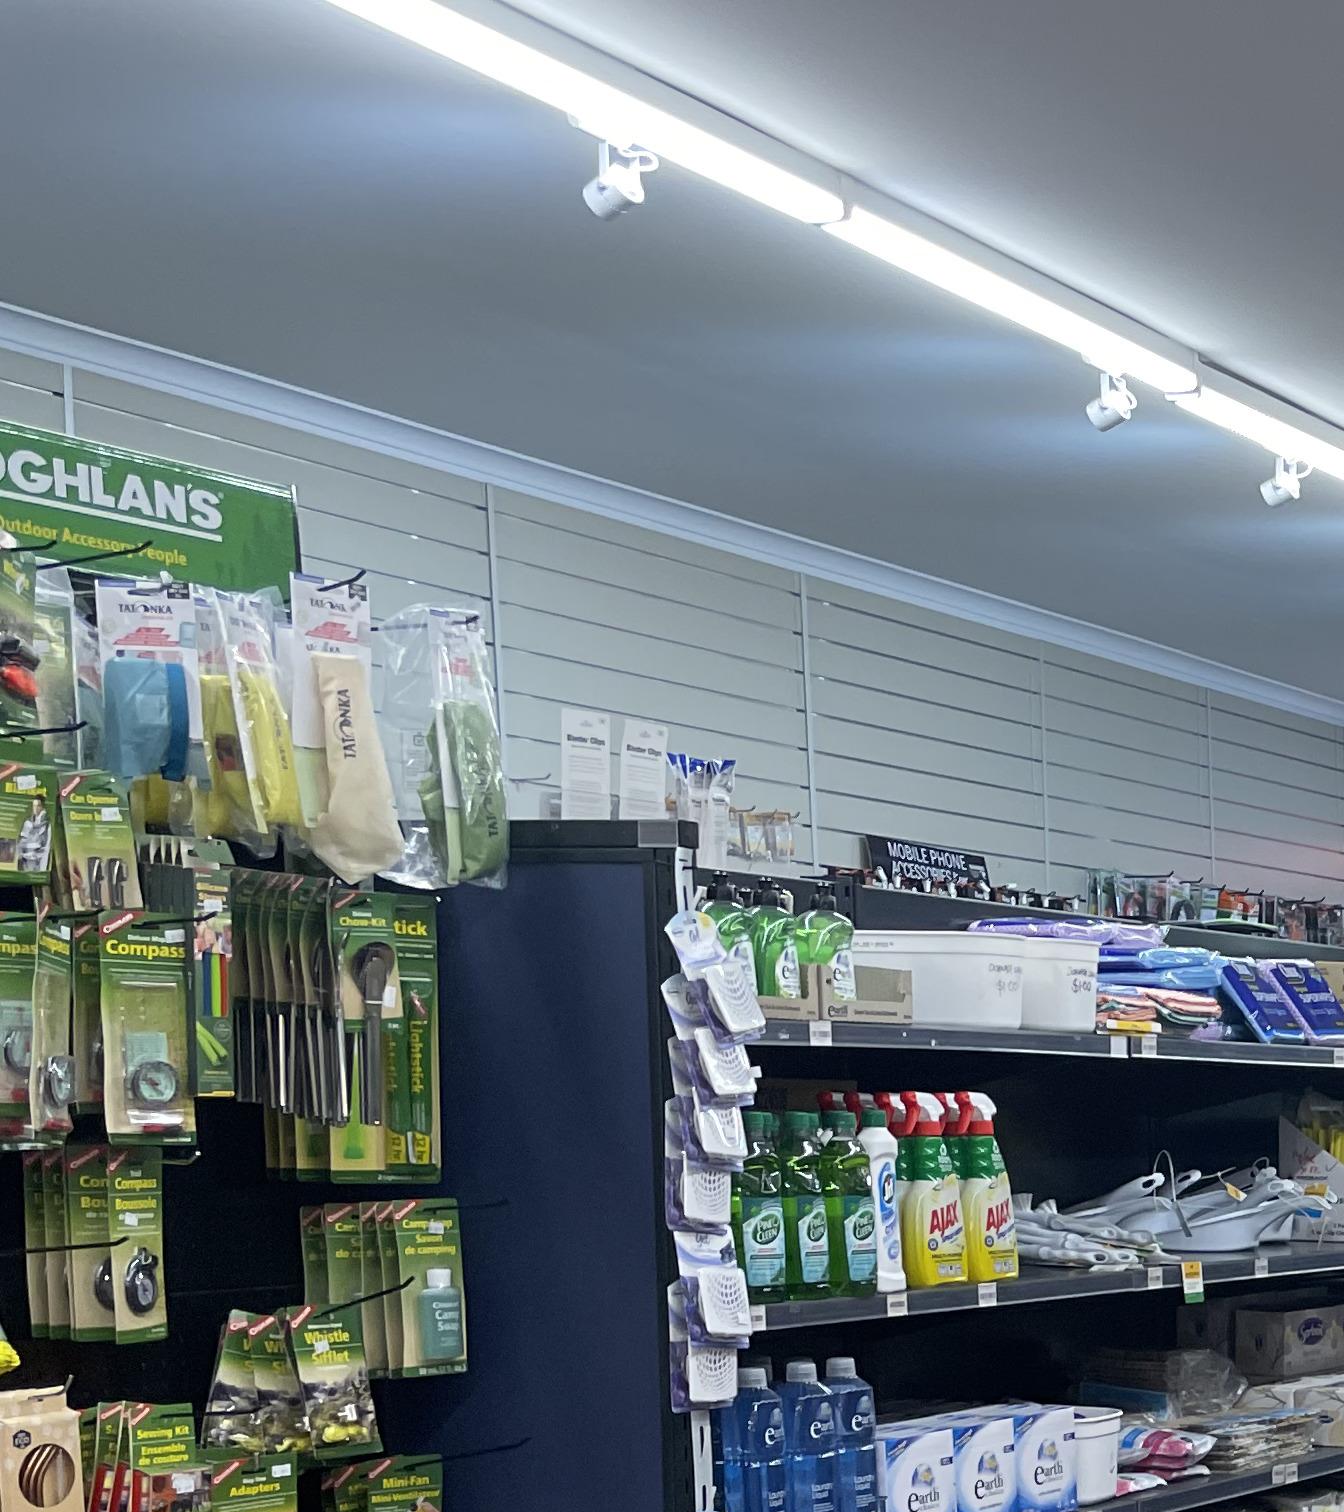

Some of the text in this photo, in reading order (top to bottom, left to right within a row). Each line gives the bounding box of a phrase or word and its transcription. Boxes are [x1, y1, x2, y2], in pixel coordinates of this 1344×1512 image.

[0, 450, 222, 530] GHLAN'S
[887, 841, 968, 872] MOBILE PHONE
[105, 940, 186, 959] Compass
[929, 1199, 959, 1239] AJAX
[985, 1200, 1010, 1238] AJAX
[304, 1331, 351, 1345] Whistle
[174, 1425, 190, 1436] Kit
[382, 1475, 430, 1489] Mini-Fan
[1034, 1459, 1063, 1485] earth
[230, 1482, 281, 1498] Adapters
[974, 1474, 1004, 1500] earth
